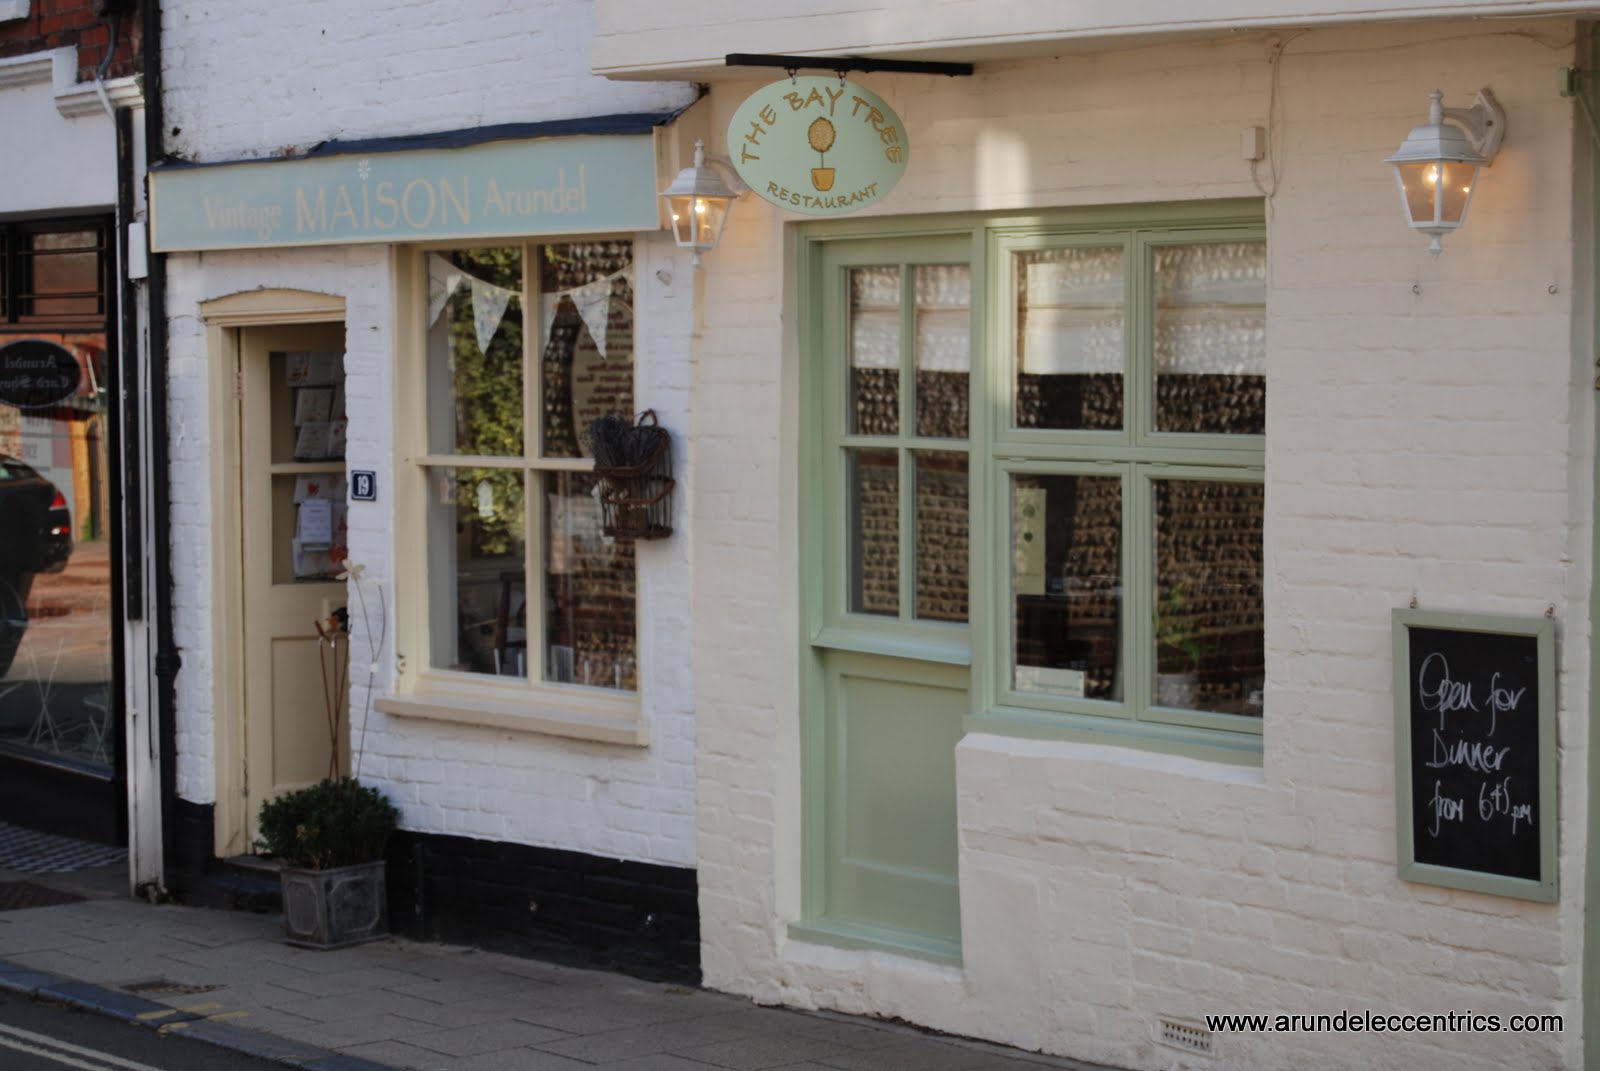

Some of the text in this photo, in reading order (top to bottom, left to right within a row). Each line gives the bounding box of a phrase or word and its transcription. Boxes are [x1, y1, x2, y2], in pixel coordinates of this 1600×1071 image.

[741, 86, 902, 164] THE BAY TREE
[203, 161, 586, 240] Vintage MAISON Arundel
[767, 181, 878, 209] RESTAURANT
[358, 475, 370, 495] 19
[1419, 652, 1526, 736] Open for
[1425, 728, 1510, 773] Dinner
[1428, 780, 1464, 837] from
